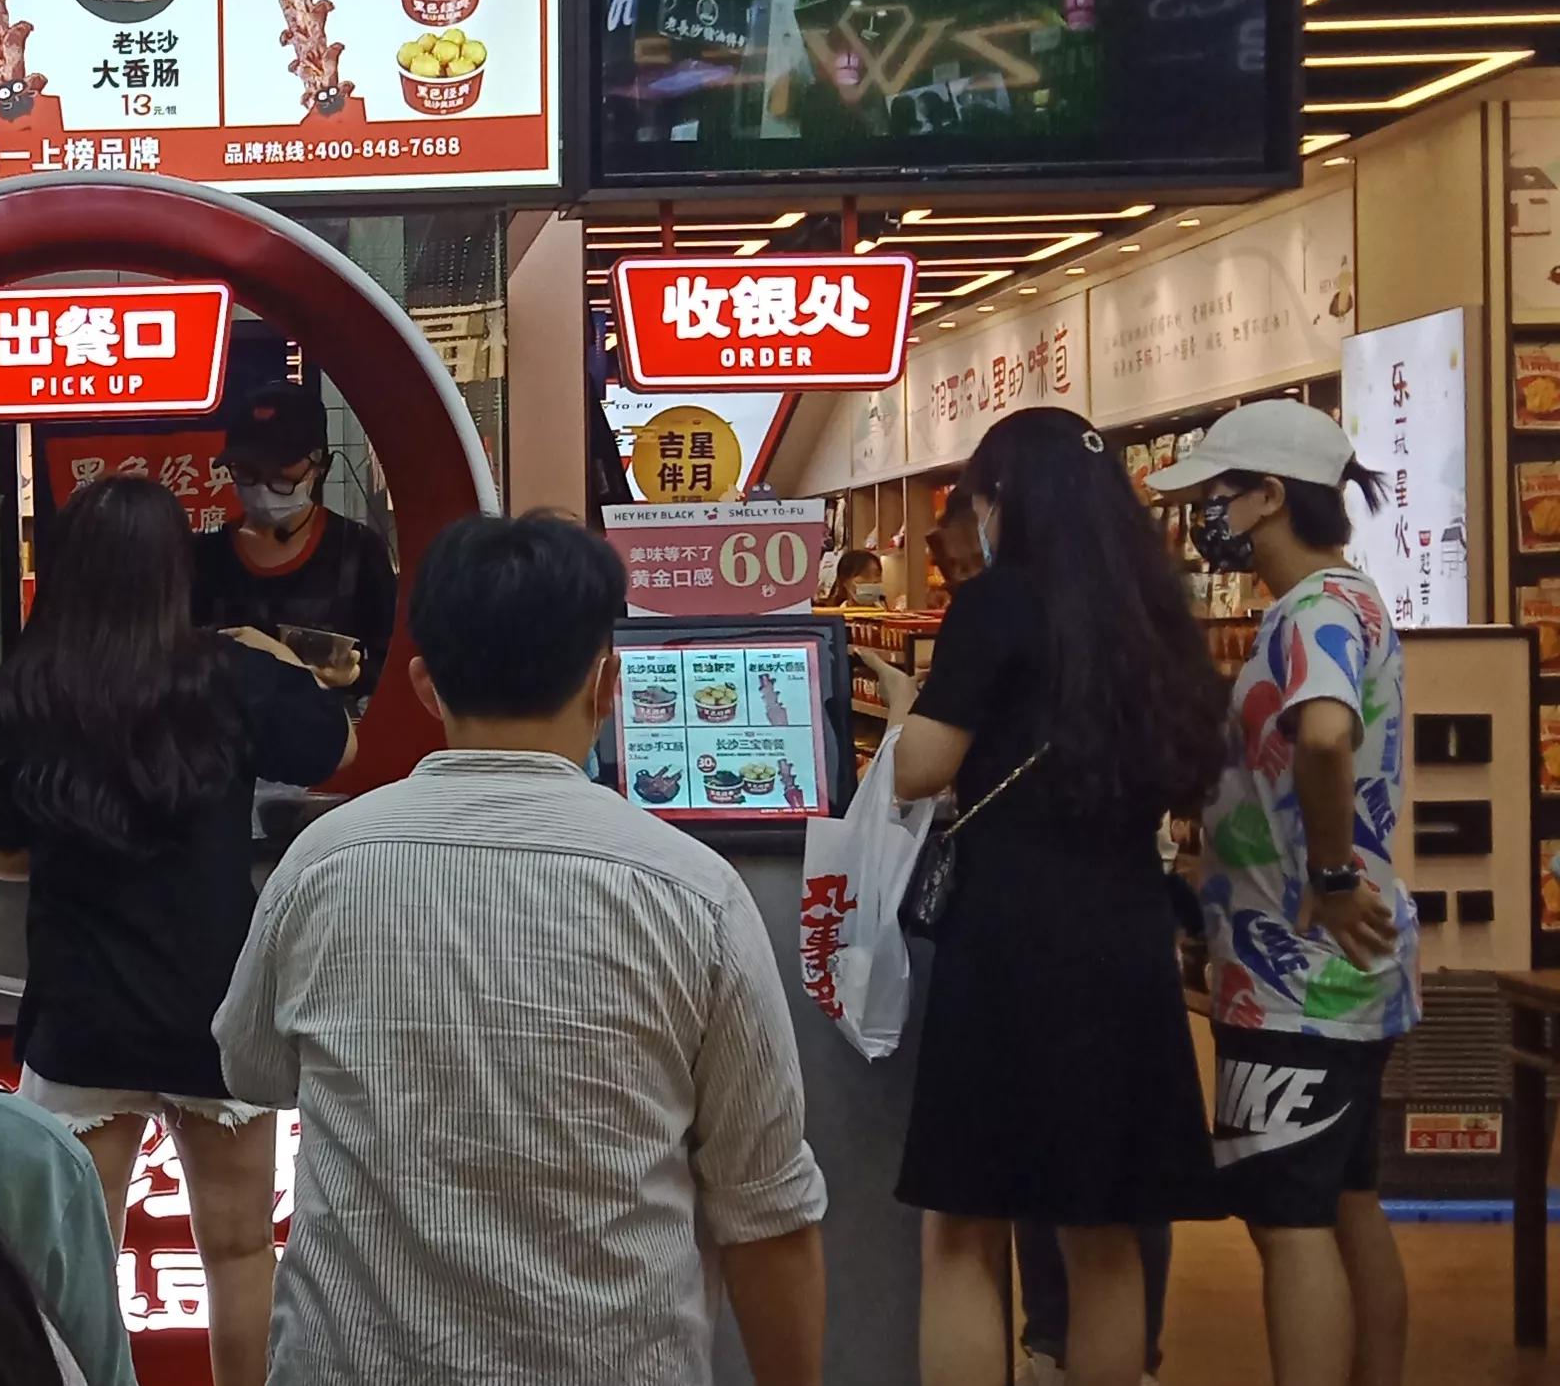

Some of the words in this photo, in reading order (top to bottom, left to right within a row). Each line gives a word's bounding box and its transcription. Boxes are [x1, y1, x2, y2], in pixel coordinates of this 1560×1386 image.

[112, 29, 179, 55] 老长沙
[92, 58, 179, 89] 大香肠
[662, 275, 871, 340] 收银处
[720, 346, 813, 367] ORDER
[30, 375, 96, 397] PICK
[108, 374, 143, 395] UP
[657, 430, 716, 461] 吉星
[657, 463, 713, 493] 伴月
[614, 512, 634, 522] HEY
[637, 511, 658, 521] HEY
[660, 510, 695, 520] BLACK
[728, 508, 768, 518] SMELLY
[772, 507, 805, 516] TO-FU
[629, 545, 713, 563] 美味等不了
[719, 530, 809, 588] 60
[631, 568, 714, 589] 黄金口感
